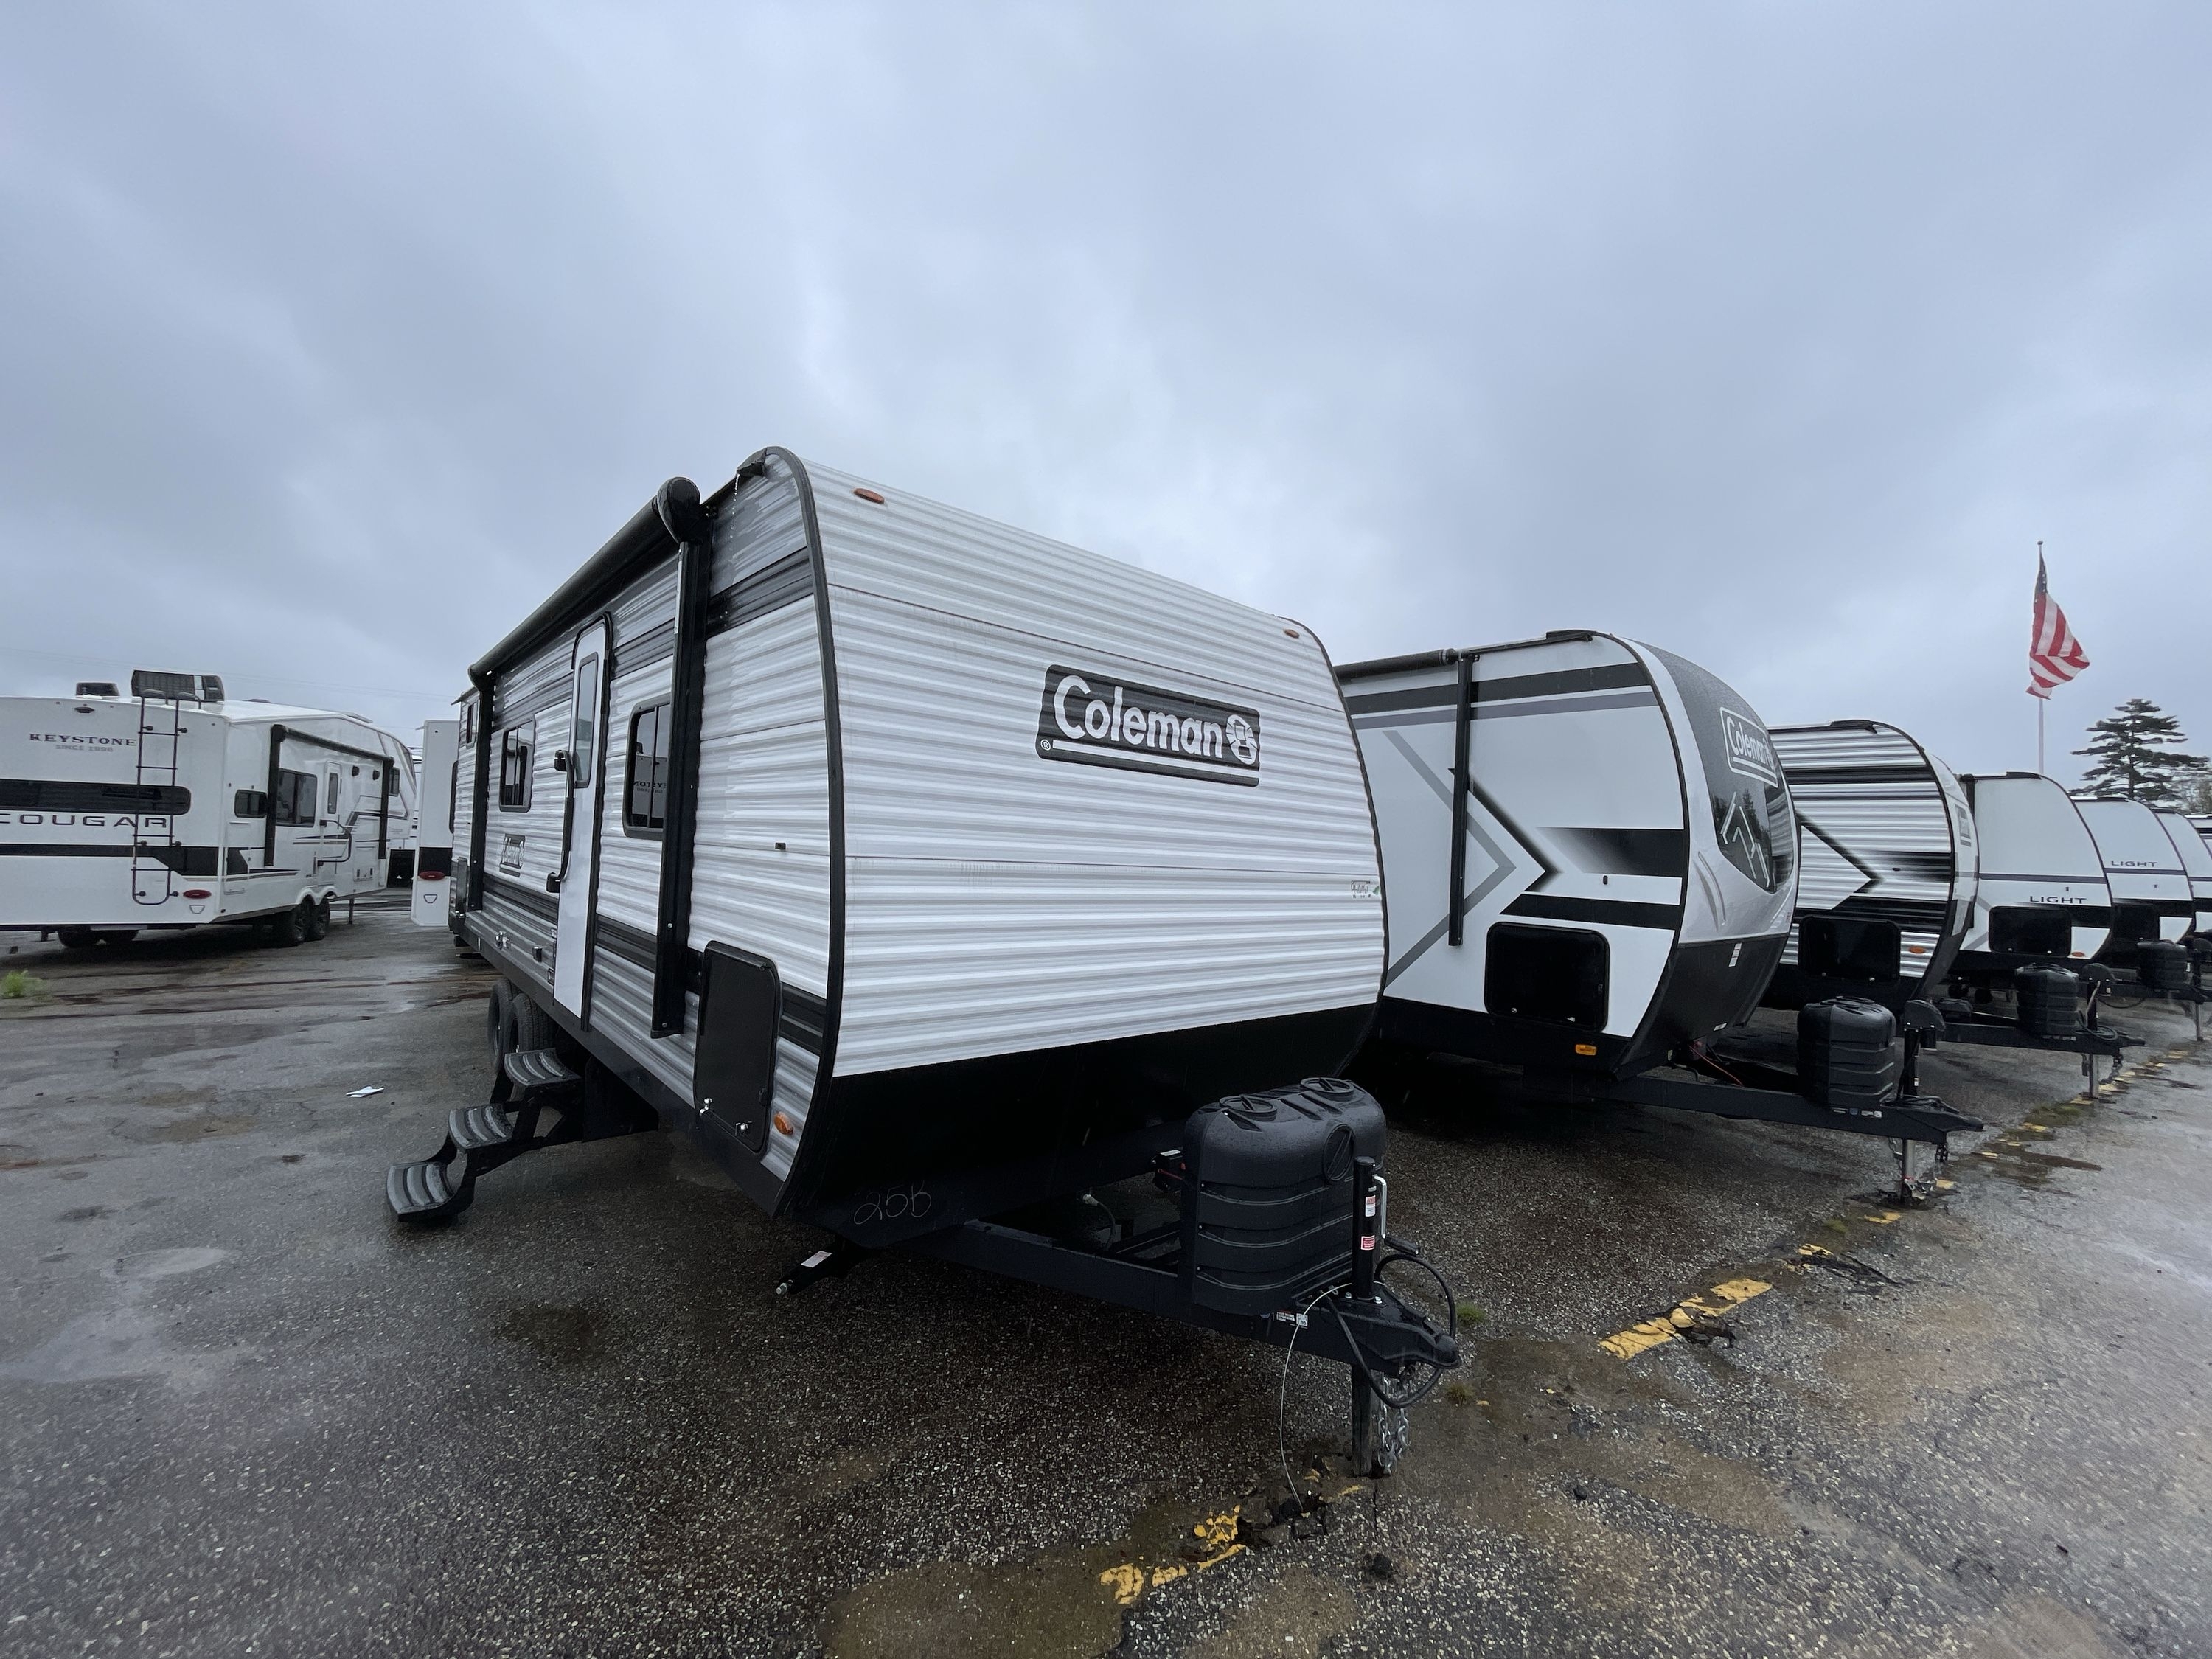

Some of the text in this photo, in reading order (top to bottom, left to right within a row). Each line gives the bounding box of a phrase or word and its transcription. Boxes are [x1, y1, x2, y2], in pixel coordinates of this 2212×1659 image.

[1053, 675, 1223, 758] Coleman
[29, 733, 137, 746] KEYSTONE
[2029, 895, 2087, 904] LIGHT
